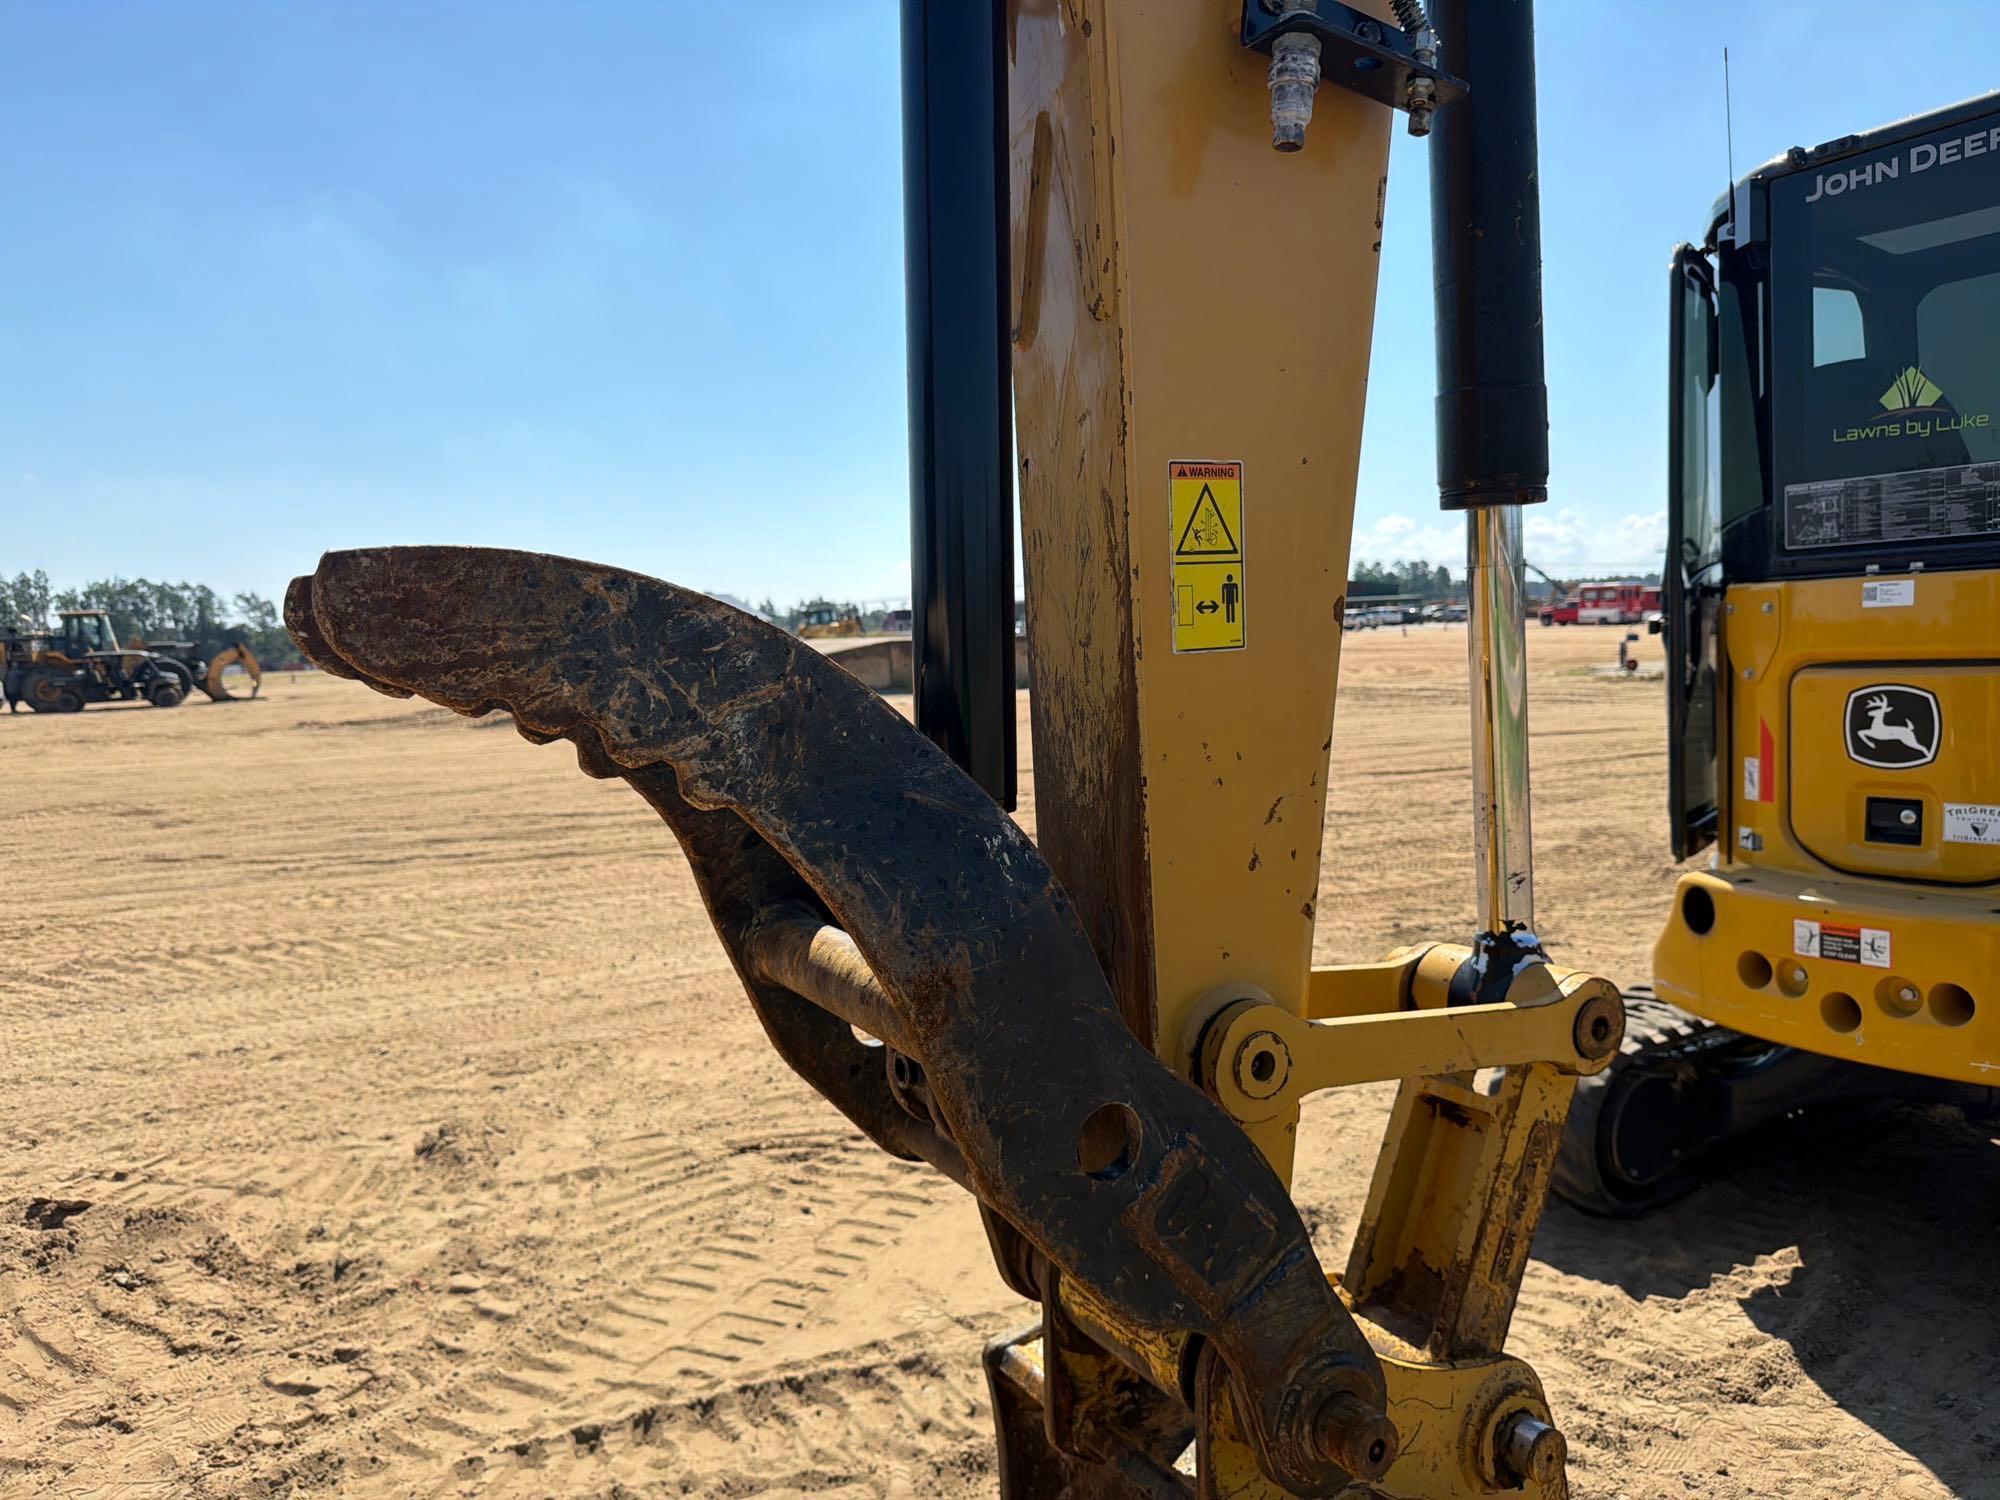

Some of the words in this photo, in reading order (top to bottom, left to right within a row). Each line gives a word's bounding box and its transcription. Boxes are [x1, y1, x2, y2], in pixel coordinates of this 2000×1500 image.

[1805, 156, 1899, 203] JOHN
[1832, 422, 1900, 442] Lawns
[1906, 419, 1930, 437] by
[1936, 413, 1989, 432] Luke
[1188, 467, 1234, 478] WARNING
